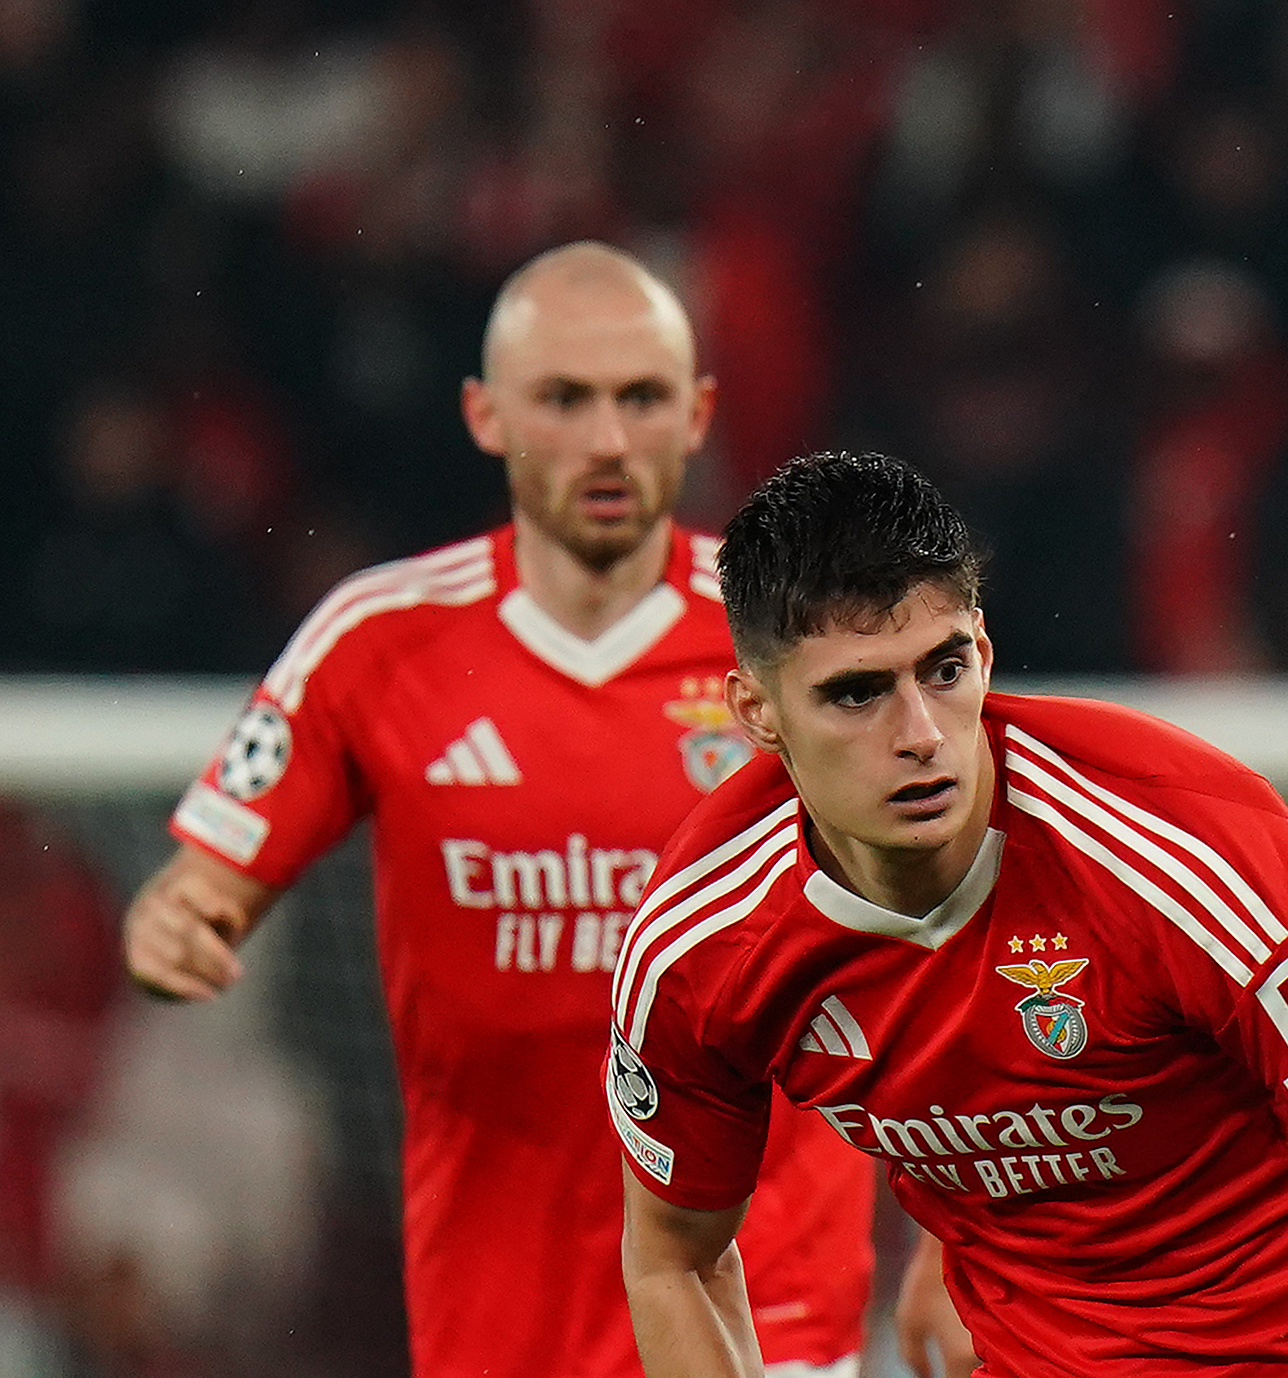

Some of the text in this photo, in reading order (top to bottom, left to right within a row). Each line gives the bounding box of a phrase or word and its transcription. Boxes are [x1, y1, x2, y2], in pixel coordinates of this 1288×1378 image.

[813, 1093, 1144, 1158] Emirates
[901, 1146, 1127, 1199] FLY BETTER
